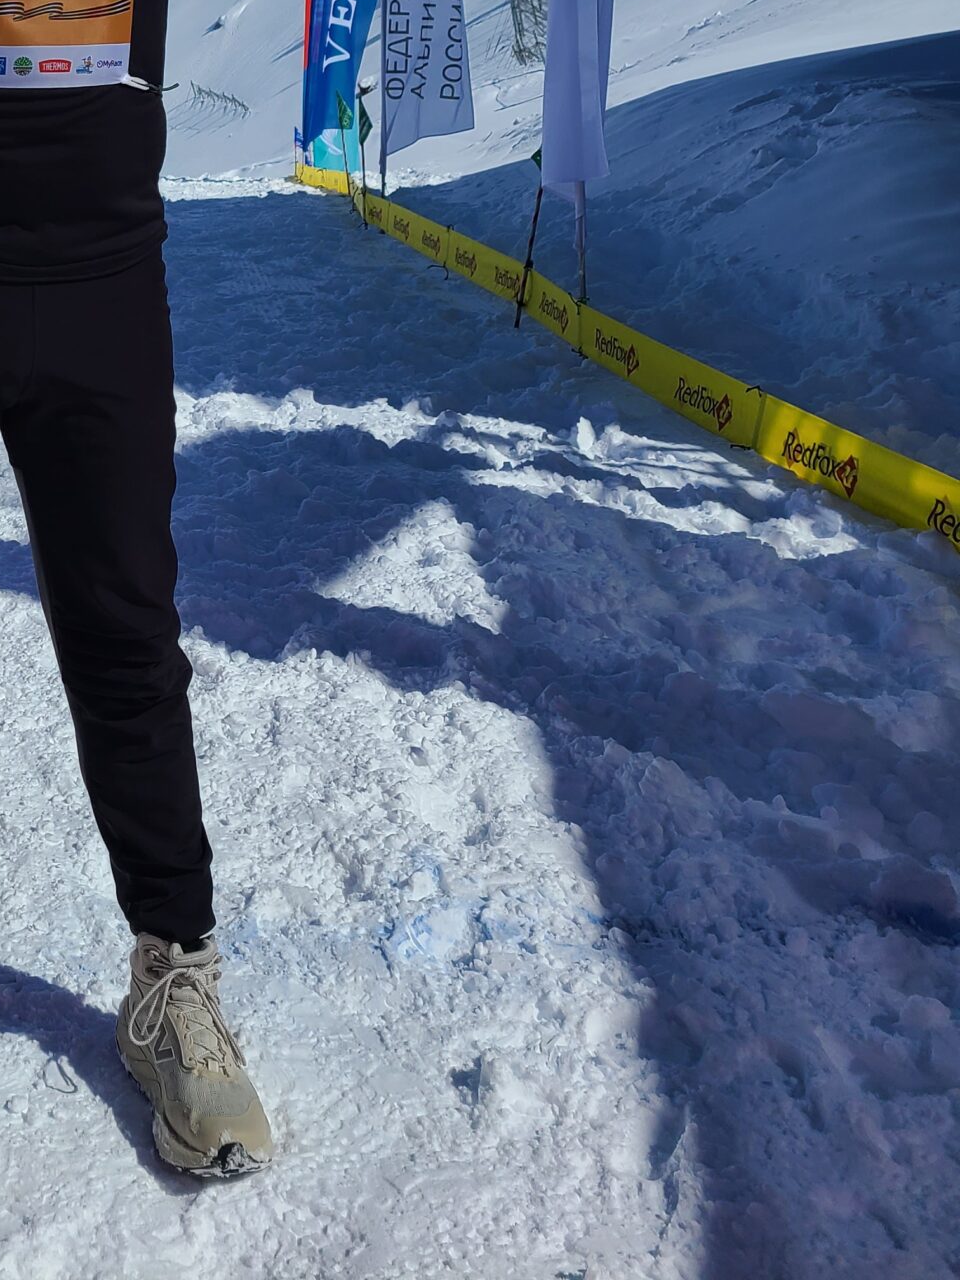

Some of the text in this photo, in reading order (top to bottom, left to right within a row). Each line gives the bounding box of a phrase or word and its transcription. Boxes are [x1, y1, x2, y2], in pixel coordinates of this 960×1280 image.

[42, 62, 69, 71] THERMOS
[595, 328, 628, 365] RedFox
[674, 376, 719, 413] RedFox
[781, 431, 841, 481] RedFox
